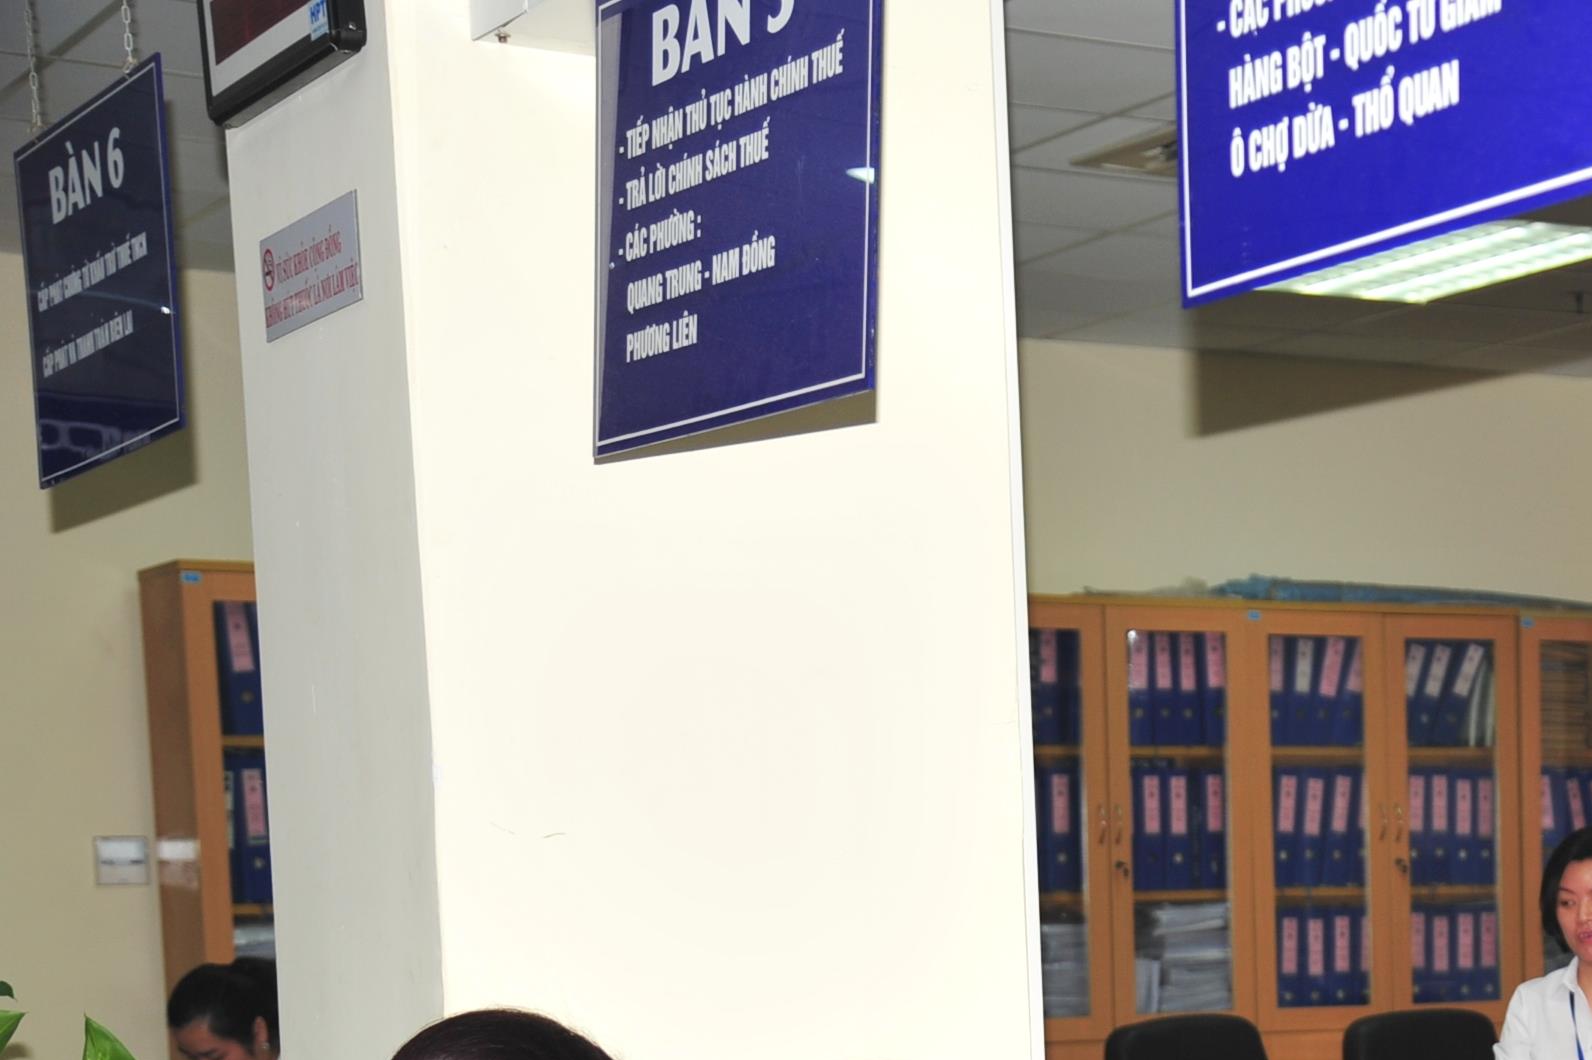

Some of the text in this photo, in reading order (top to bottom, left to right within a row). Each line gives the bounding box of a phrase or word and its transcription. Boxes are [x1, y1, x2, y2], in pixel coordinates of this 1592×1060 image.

[626, 28, 845, 159] TIẾP NHẬN THỦ TỤC HÀNH CHÍNH THUẾ
[1229, 51, 1283, 109] HÀNG
[1286, 31, 1326, 93] BỘT
[1230, 59, 1460, 178] Ô CHỢ DỪA THỔ QUAN
[48, 127, 124, 225] BÀN 6
[626, 116, 771, 210] TRẢ LỜI CHÍNH SÁCH THUẾ
[626, 223, 647, 262] CÁC
[627, 273, 663, 315] QUANG
[665, 260, 702, 300] TRUNG
[712, 247, 740, 285] NAM
[626, 310, 698, 363] PHƯƠNG LIÊN
